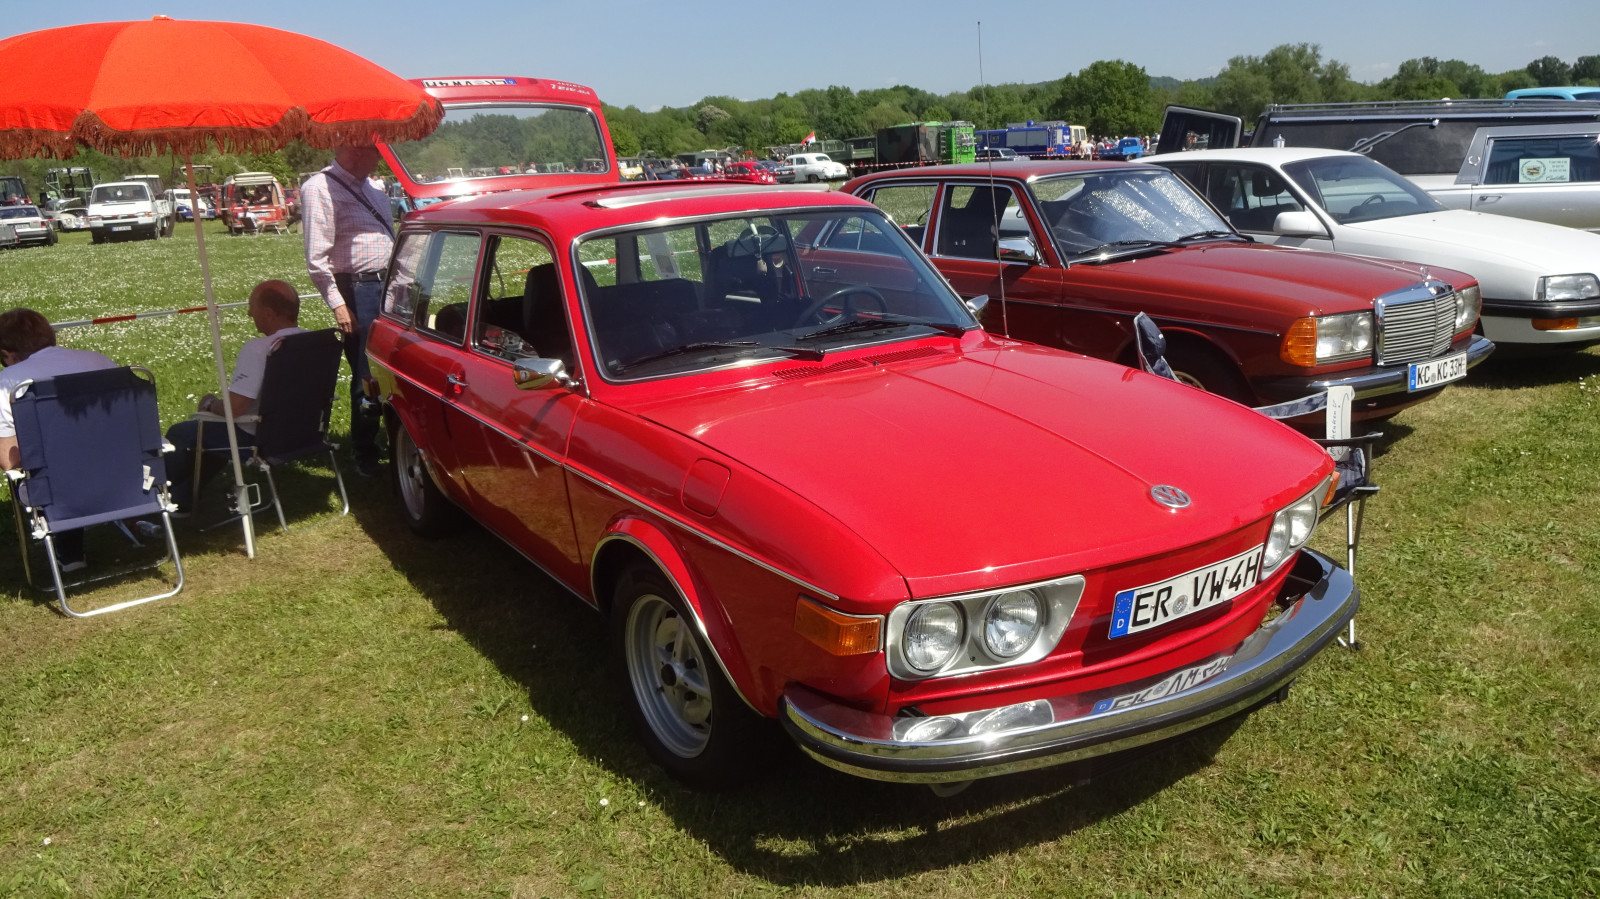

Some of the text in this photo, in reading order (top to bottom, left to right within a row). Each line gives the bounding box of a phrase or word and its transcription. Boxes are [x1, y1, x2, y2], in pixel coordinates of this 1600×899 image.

[1417, 357, 1463, 386] KC KC 33H
[1116, 618, 1125, 629] D
[1131, 585, 1173, 628] ER
